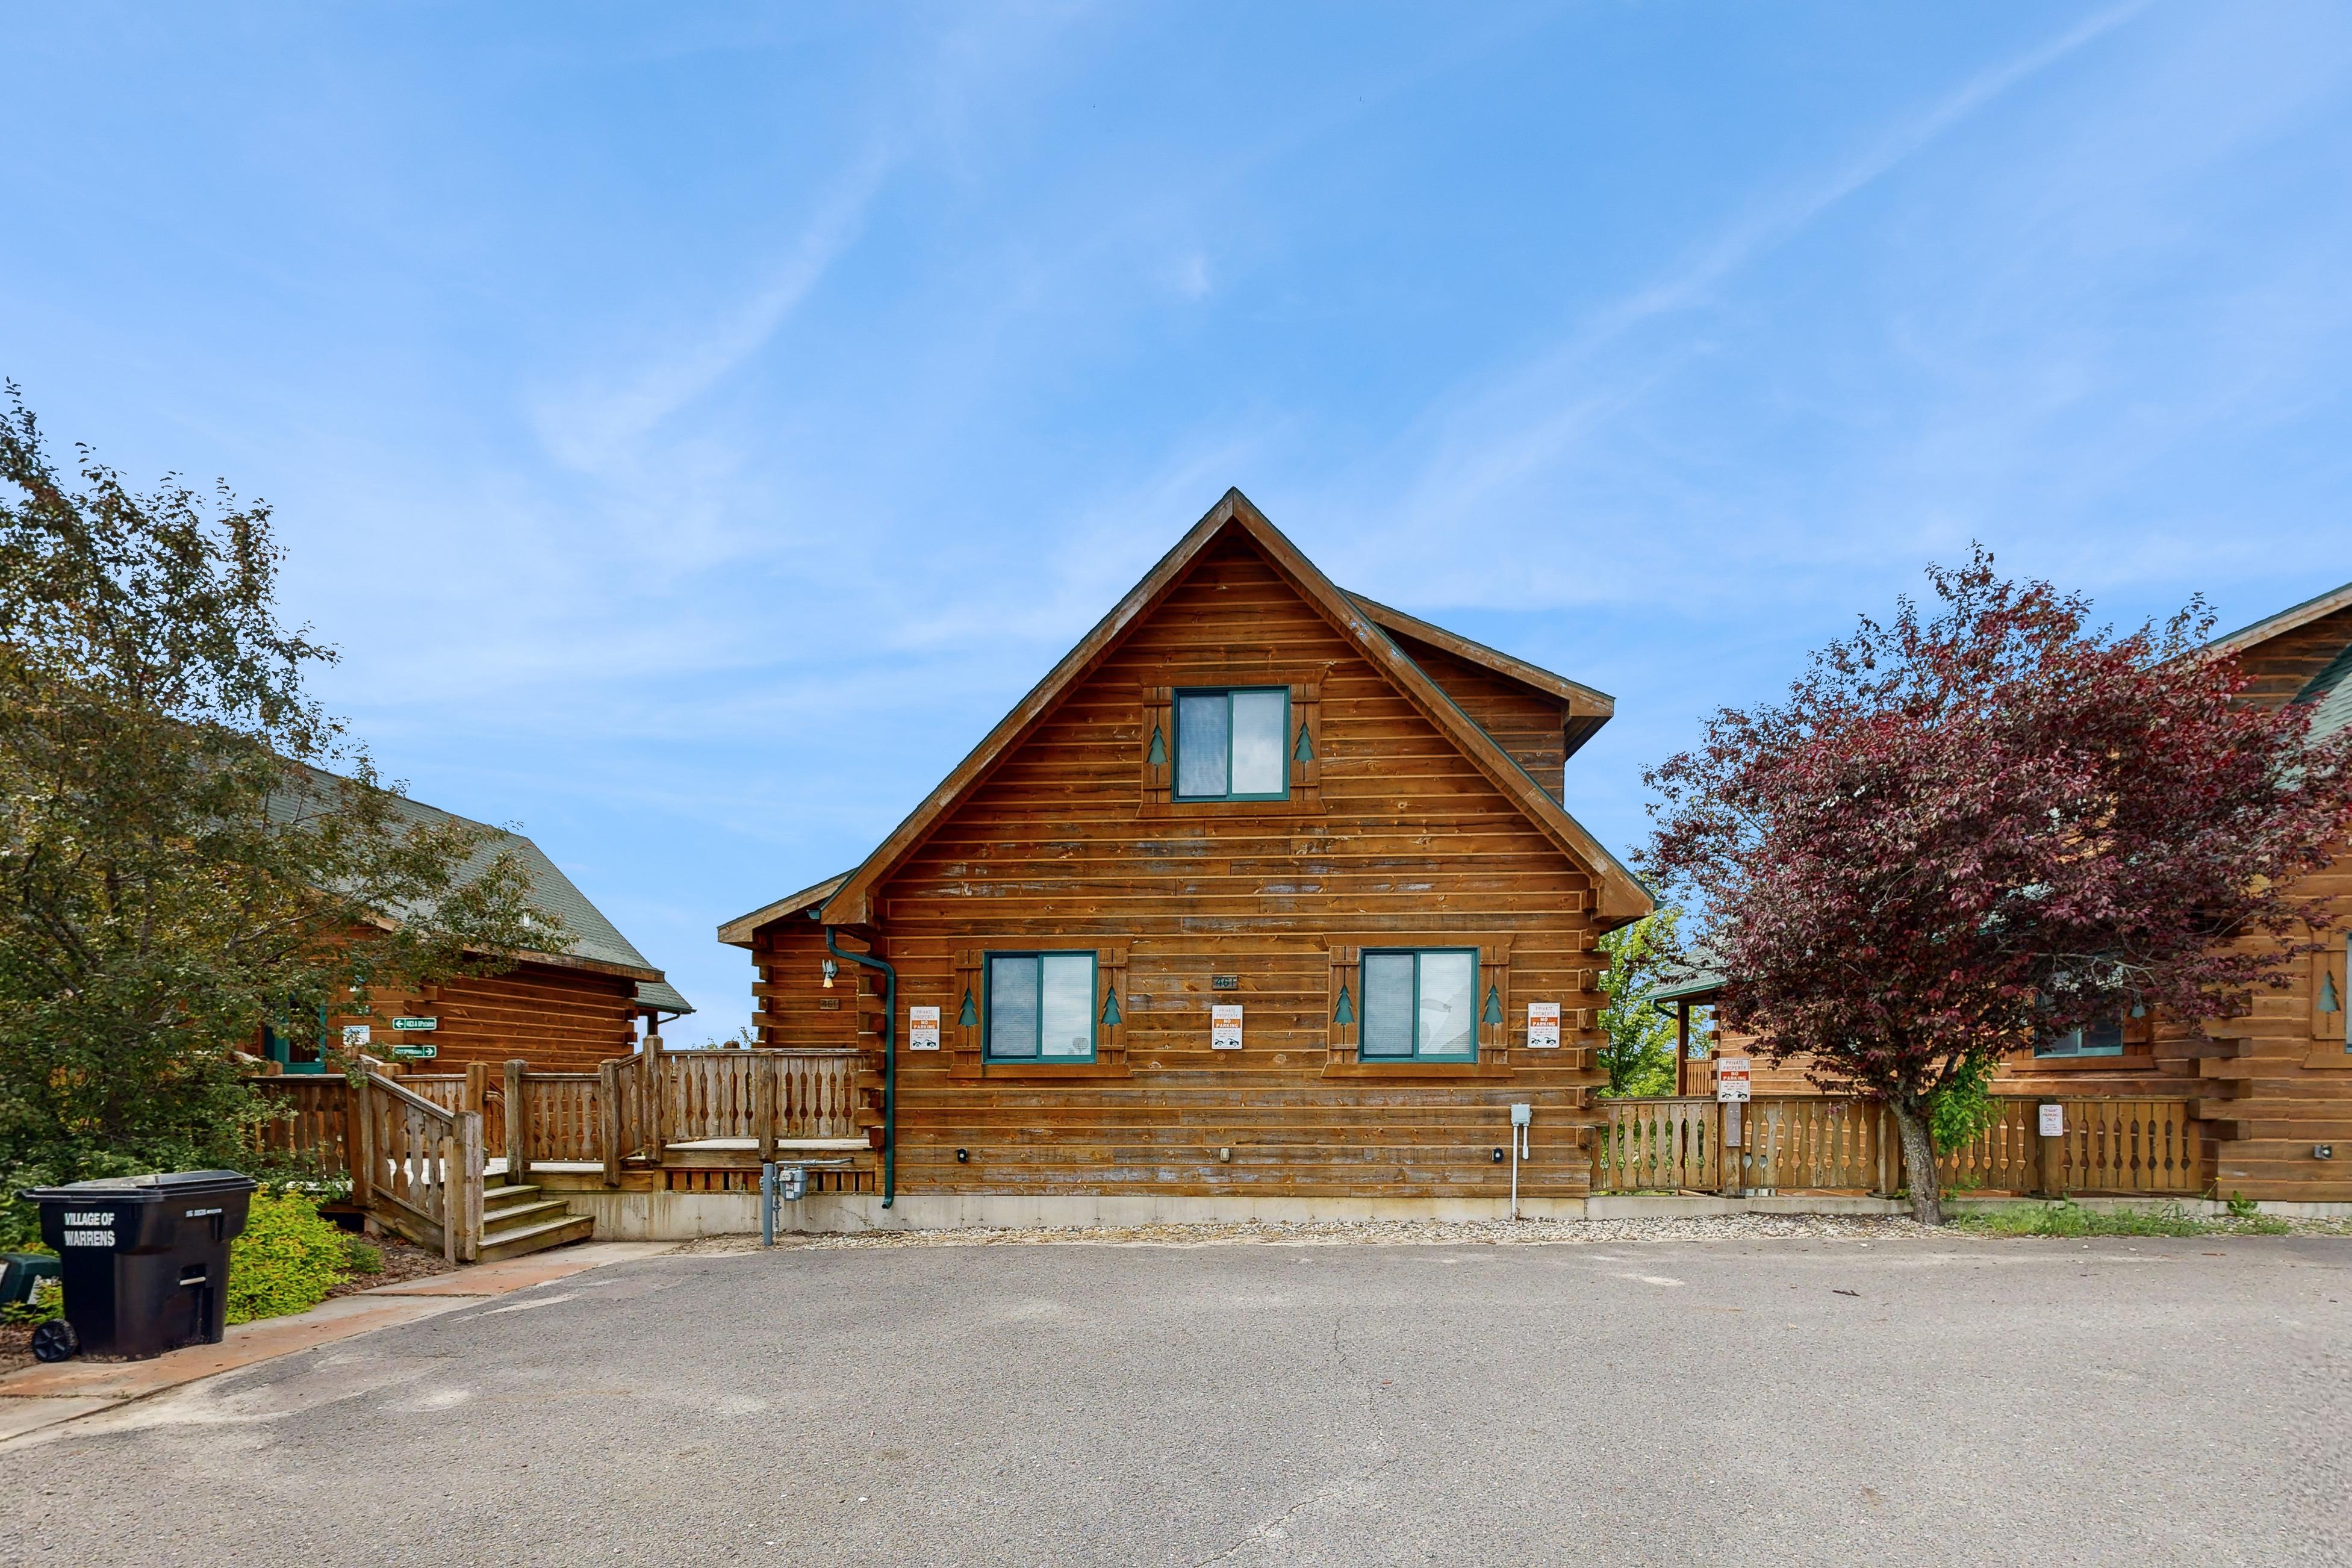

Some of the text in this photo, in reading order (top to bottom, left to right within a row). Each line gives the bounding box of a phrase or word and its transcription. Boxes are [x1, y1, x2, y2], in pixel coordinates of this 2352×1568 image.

[64, 1213, 115, 1225] VILLAGE OF
[64, 1230, 116, 1246] WARRENS
